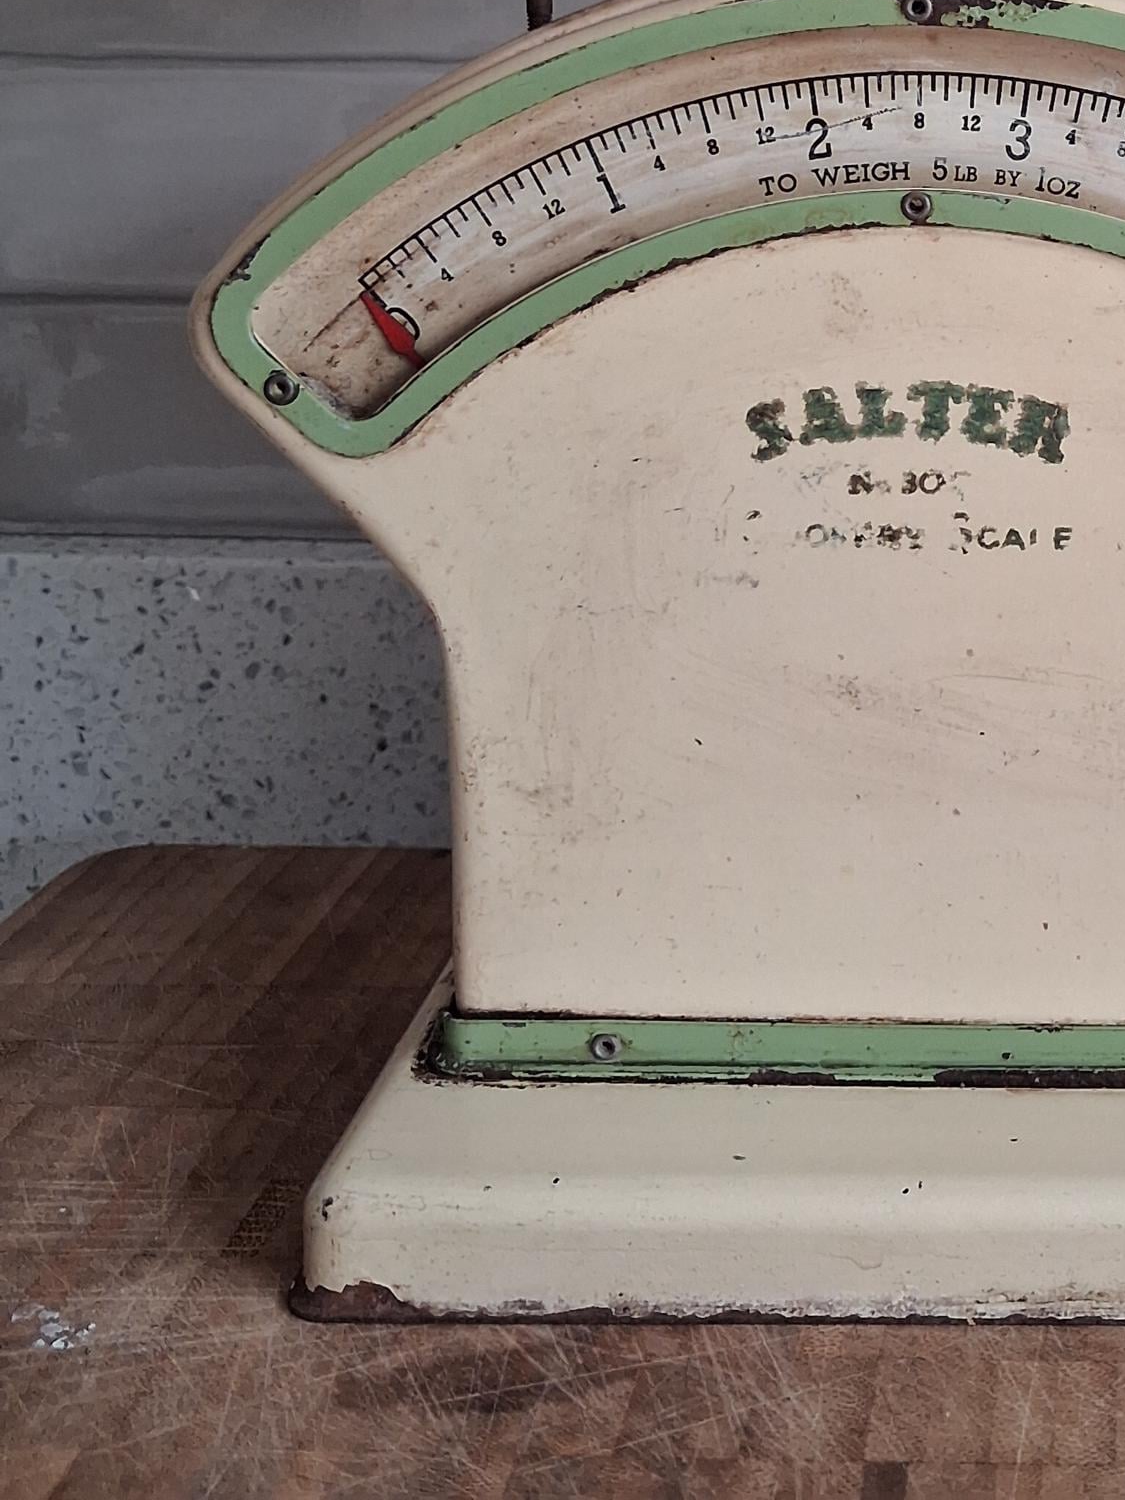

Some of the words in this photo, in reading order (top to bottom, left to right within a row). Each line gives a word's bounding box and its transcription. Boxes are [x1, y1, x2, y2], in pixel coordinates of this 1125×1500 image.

[440, 267, 454, 282] 4
[491, 230, 507, 247] 8
[542, 198, 566, 220] 12
[596, 173, 626, 214] 1
[652, 155, 667, 172] 4
[706, 138, 720, 156] 8
[755, 126, 775, 145] 12
[805, 118, 832, 160] 2
[862, 115, 874, 132] 4
[913, 112, 926, 130] 8
[961, 115, 982, 132] 12
[1005, 118, 1032, 161] 3
[1065, 129, 1078, 145] 4
[758, 173, 798, 197] TO
[811, 161, 910, 187] WEIGH
[993, 169, 1022, 188] BY
[745, 380, 1070, 464] SALTER
